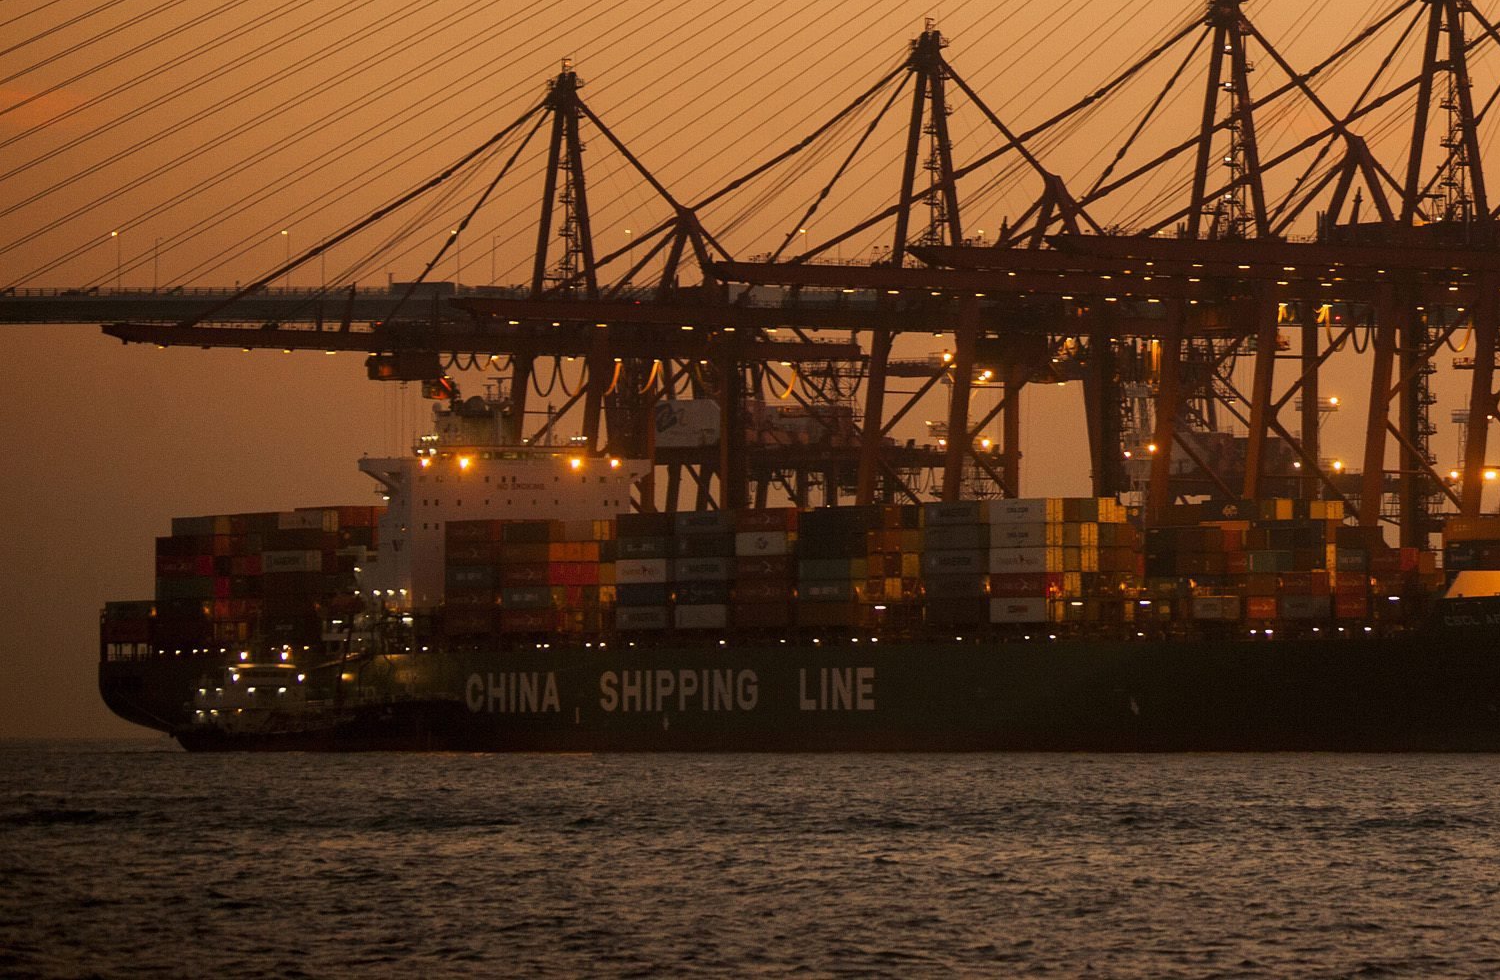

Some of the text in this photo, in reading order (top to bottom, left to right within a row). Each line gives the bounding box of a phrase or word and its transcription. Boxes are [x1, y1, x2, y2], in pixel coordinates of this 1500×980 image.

[465, 667, 876, 713] CHINA SHIPPING LINE
